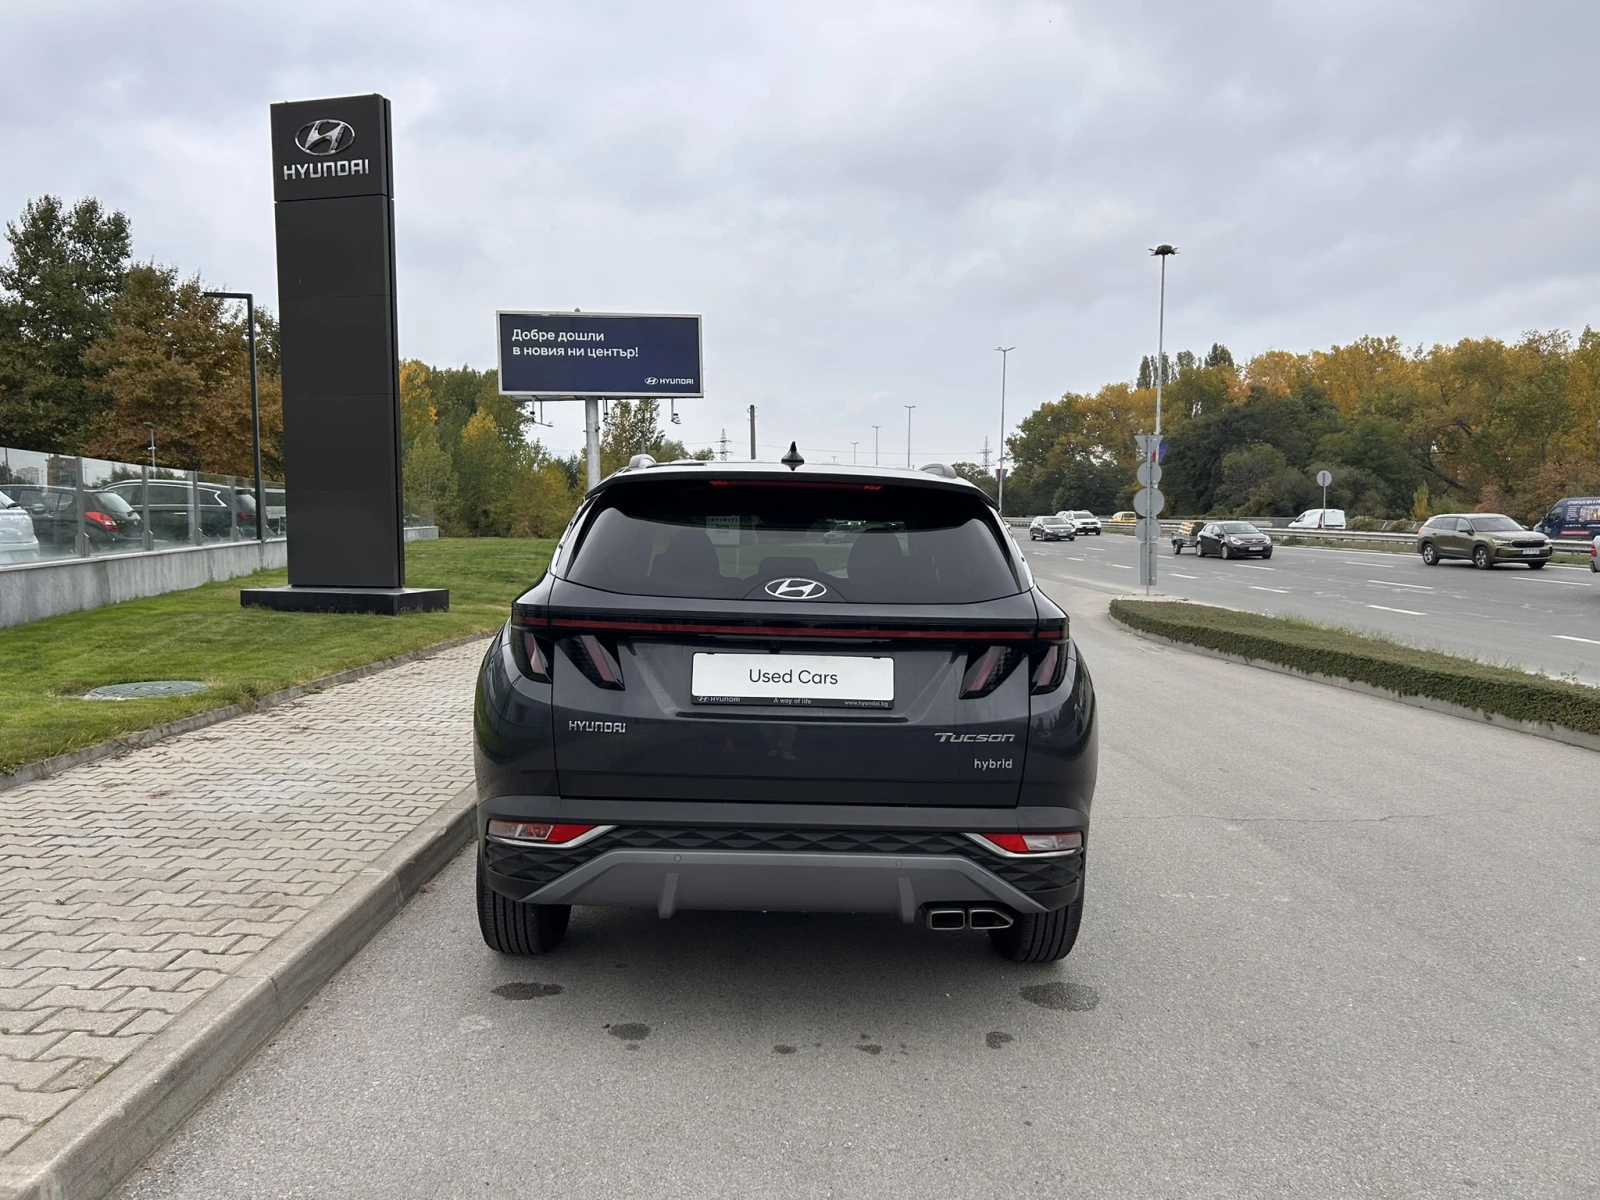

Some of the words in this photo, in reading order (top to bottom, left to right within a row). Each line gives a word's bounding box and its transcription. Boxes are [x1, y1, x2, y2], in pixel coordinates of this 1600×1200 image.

[283, 159, 369, 180] HYUNDAI
[511, 329, 556, 342] Добре
[558, 331, 605, 342] дошли
[512, 346, 521, 355] в
[523, 346, 565, 356] новия
[567, 347, 585, 356] ни
[587, 346, 639, 359] център!
[749, 668, 793, 684] Used
[798, 669, 839, 685] Cars
[568, 720, 626, 733] HYUNDAI
[973, 758, 1013, 771] hybrid
